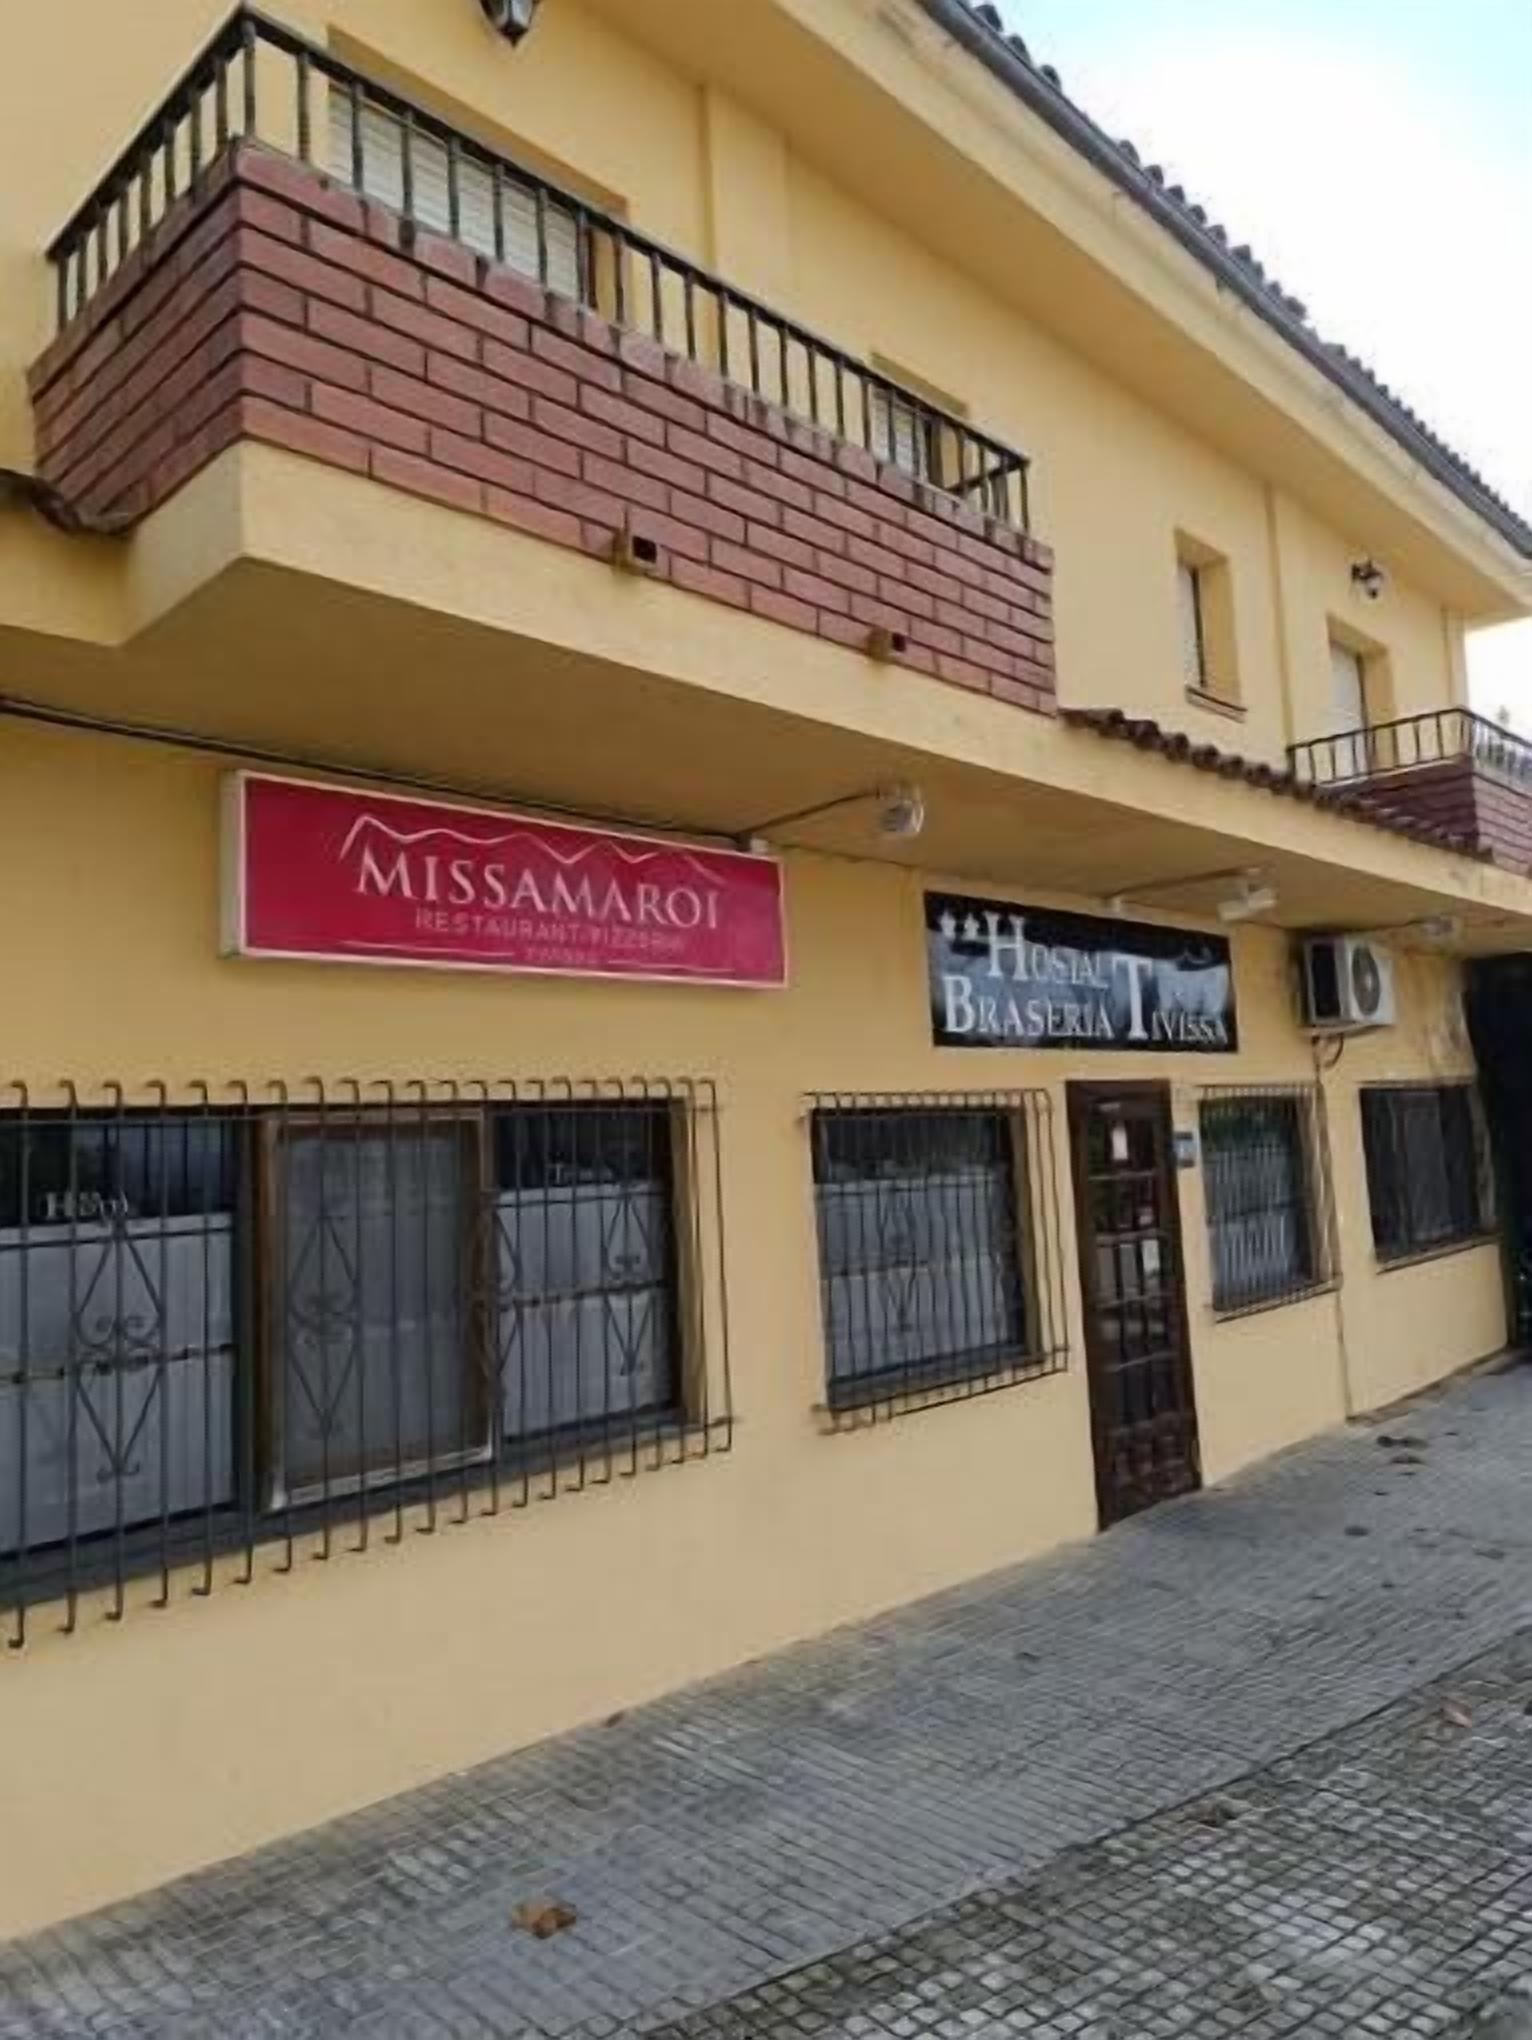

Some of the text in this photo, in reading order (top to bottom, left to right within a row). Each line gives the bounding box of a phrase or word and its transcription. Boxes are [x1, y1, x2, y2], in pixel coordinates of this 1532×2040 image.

[355, 843, 720, 931] MISSAMAROI
[415, 907, 581, 944] RESTAURANT
[943, 974, 1115, 1040] BRASERIA
